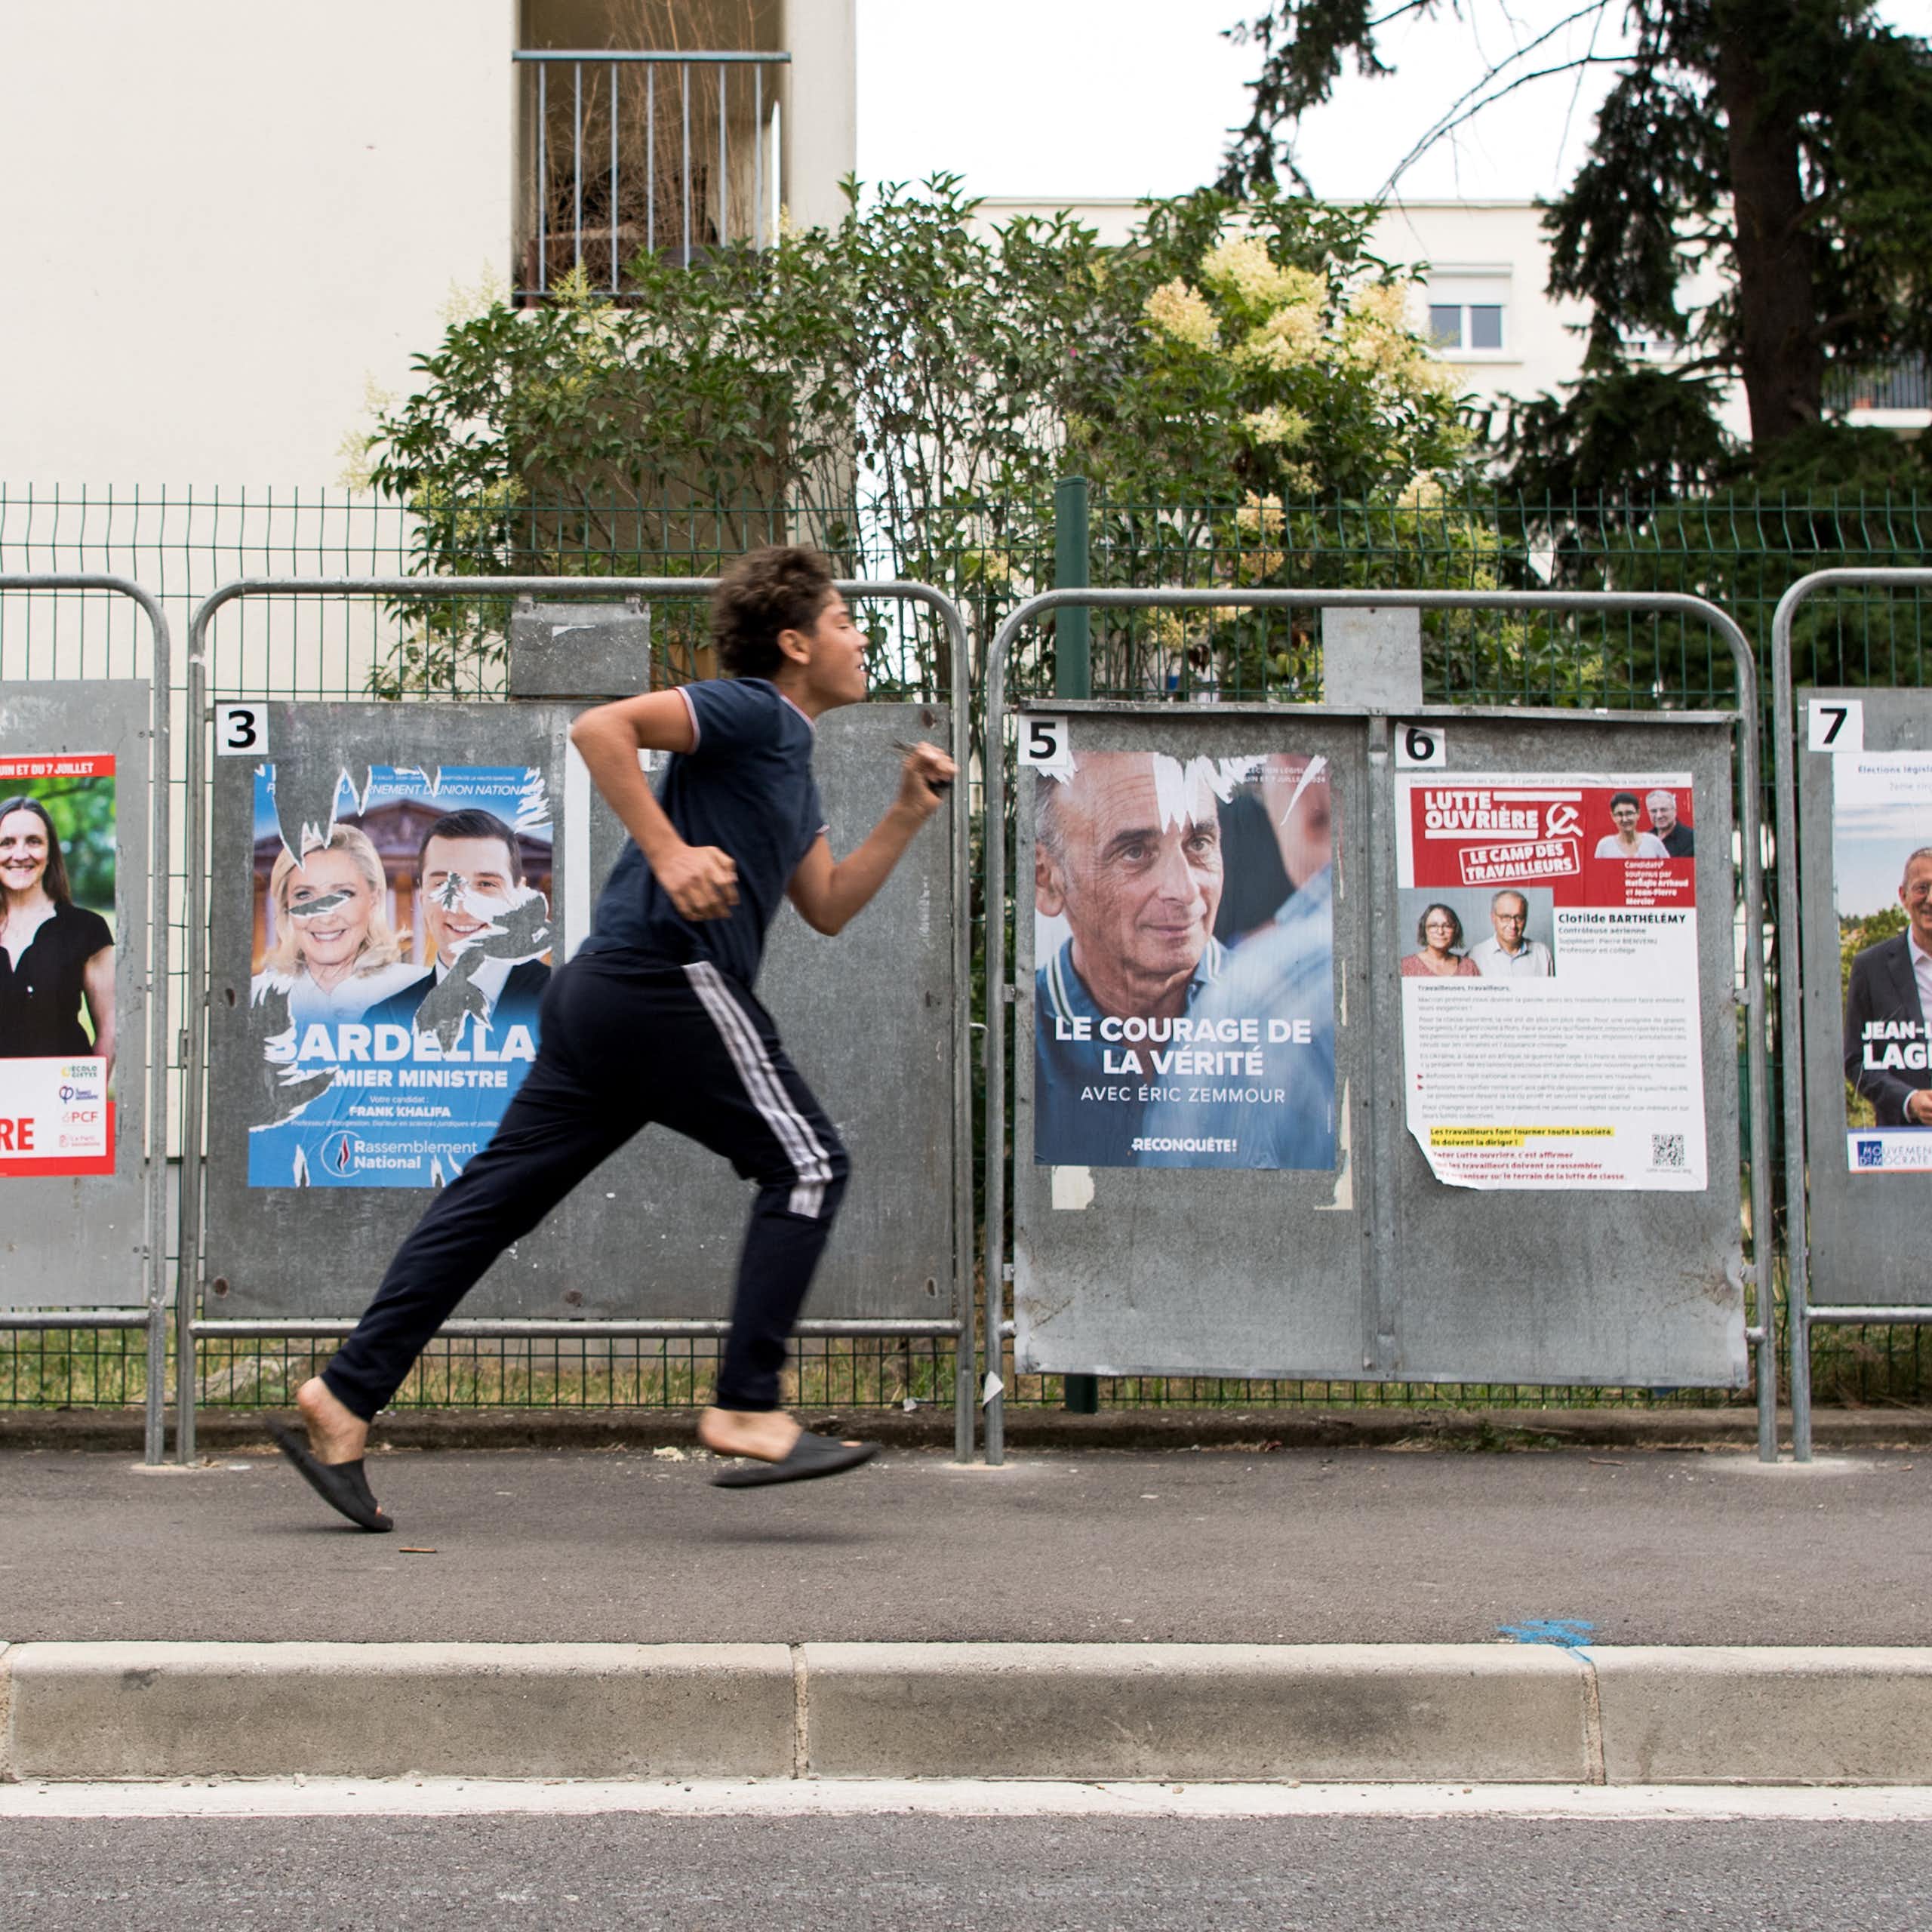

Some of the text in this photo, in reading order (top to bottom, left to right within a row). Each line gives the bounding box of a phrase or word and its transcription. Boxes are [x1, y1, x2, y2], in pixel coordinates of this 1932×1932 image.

[227, 710, 257, 749] 3
[1820, 708, 1847, 745] 7
[1028, 721, 1057, 759] 5
[1405, 728, 1435, 761] 6
[17, 764, 29, 775] ET
[31, 764, 45, 775] DU
[46, 763, 54, 774] 7
[54, 762, 94, 774] JUILLET
[1425, 791, 1492, 810] LUTTE
[1425, 804, 1540, 829] OUVRIÈRE
[1469, 843, 1564, 865] LE CAMP DES
[1466, 857, 1573, 881] TRAVAILLEURS
[1558, 912, 1686, 924] Clotilde BARTHÉLÉMY
[1055, 1017, 1312, 1044] LE COURAGE DE
[1103, 1044, 1263, 1076] LA VÉRITÉ
[1863, 1042, 1932, 1070] LAG
[398, 1069, 508, 1088] MINISTRE
[392, 1096, 424, 1104] candidat
[1081, 1084, 1285, 1103] AVEC ÉRIC ZEMMOUR
[72, 1111, 99, 1123] PCF
[349, 1106, 451, 1118] FRANK KHALIFA
[354, 1140, 478, 1154] Rassemblement
[354, 1155, 421, 1169] National
